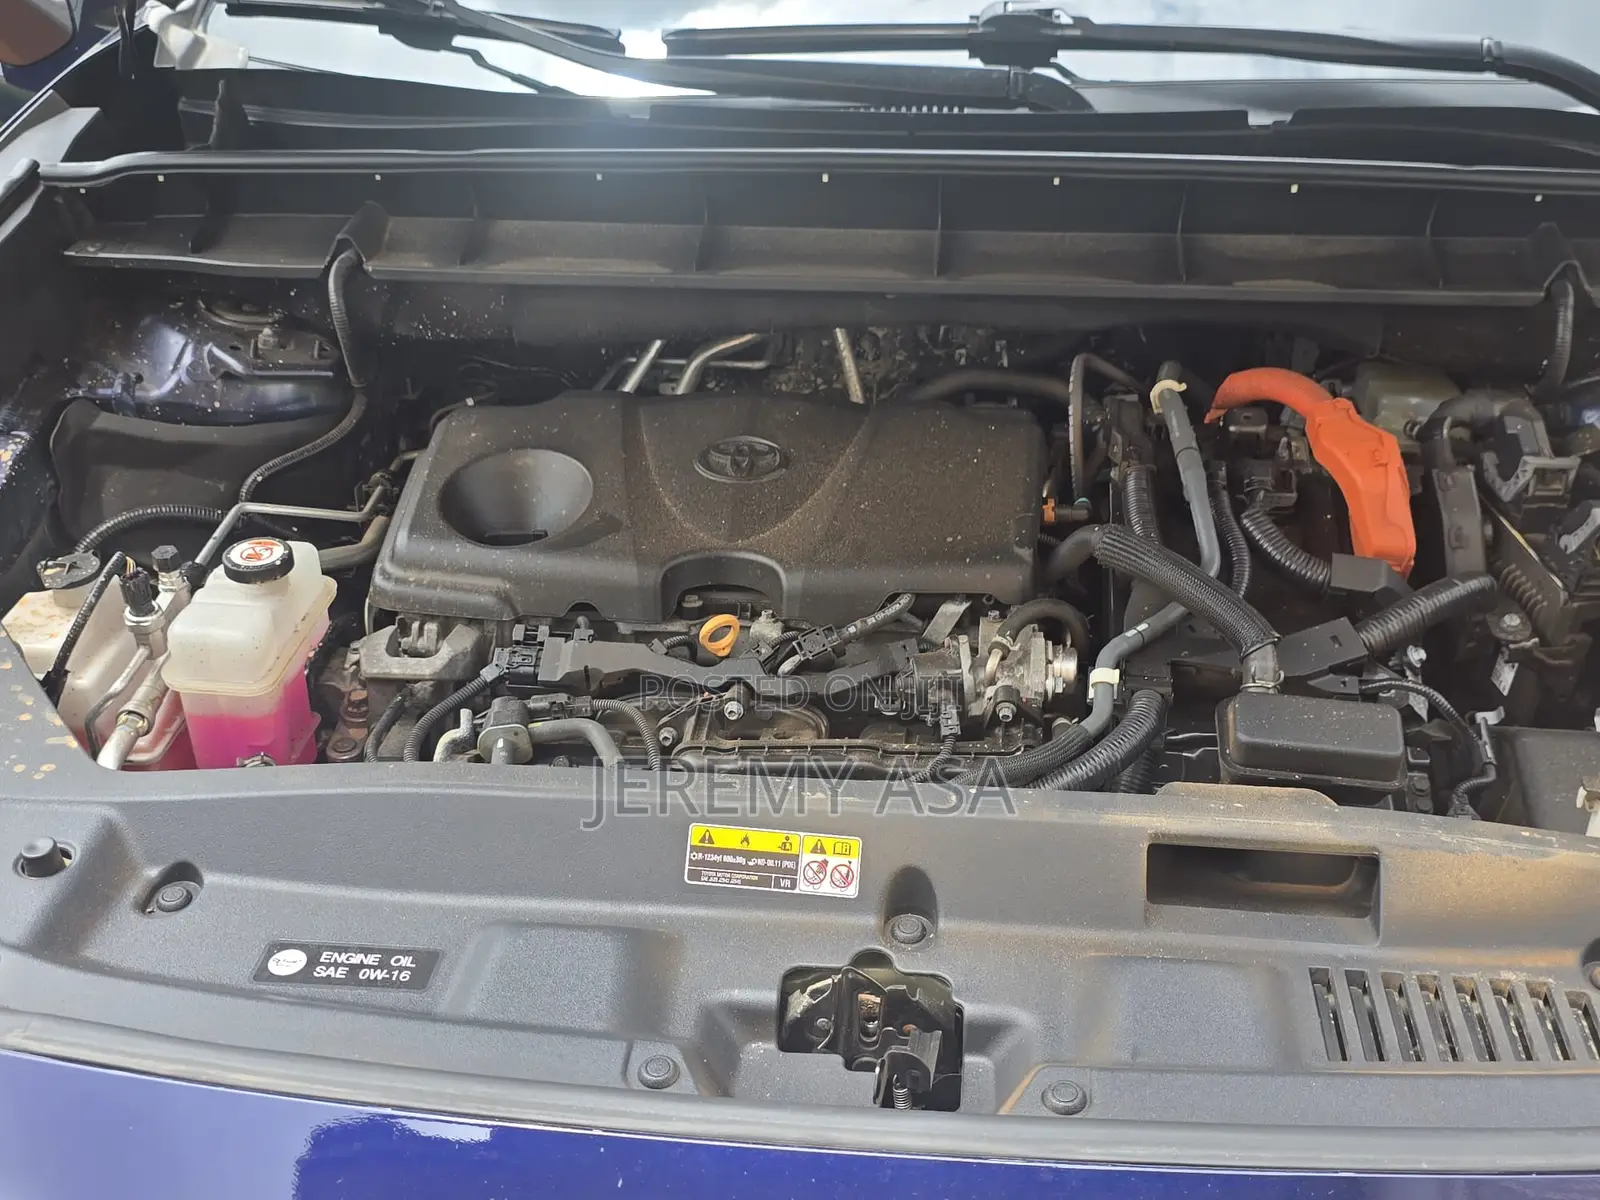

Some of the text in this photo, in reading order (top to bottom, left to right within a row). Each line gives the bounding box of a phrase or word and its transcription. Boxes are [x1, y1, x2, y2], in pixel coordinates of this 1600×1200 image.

[780, 878, 791, 888] VR
[319, 951, 417, 968] ENGINE OIL
[313, 965, 412, 982] SAE 0W-16
